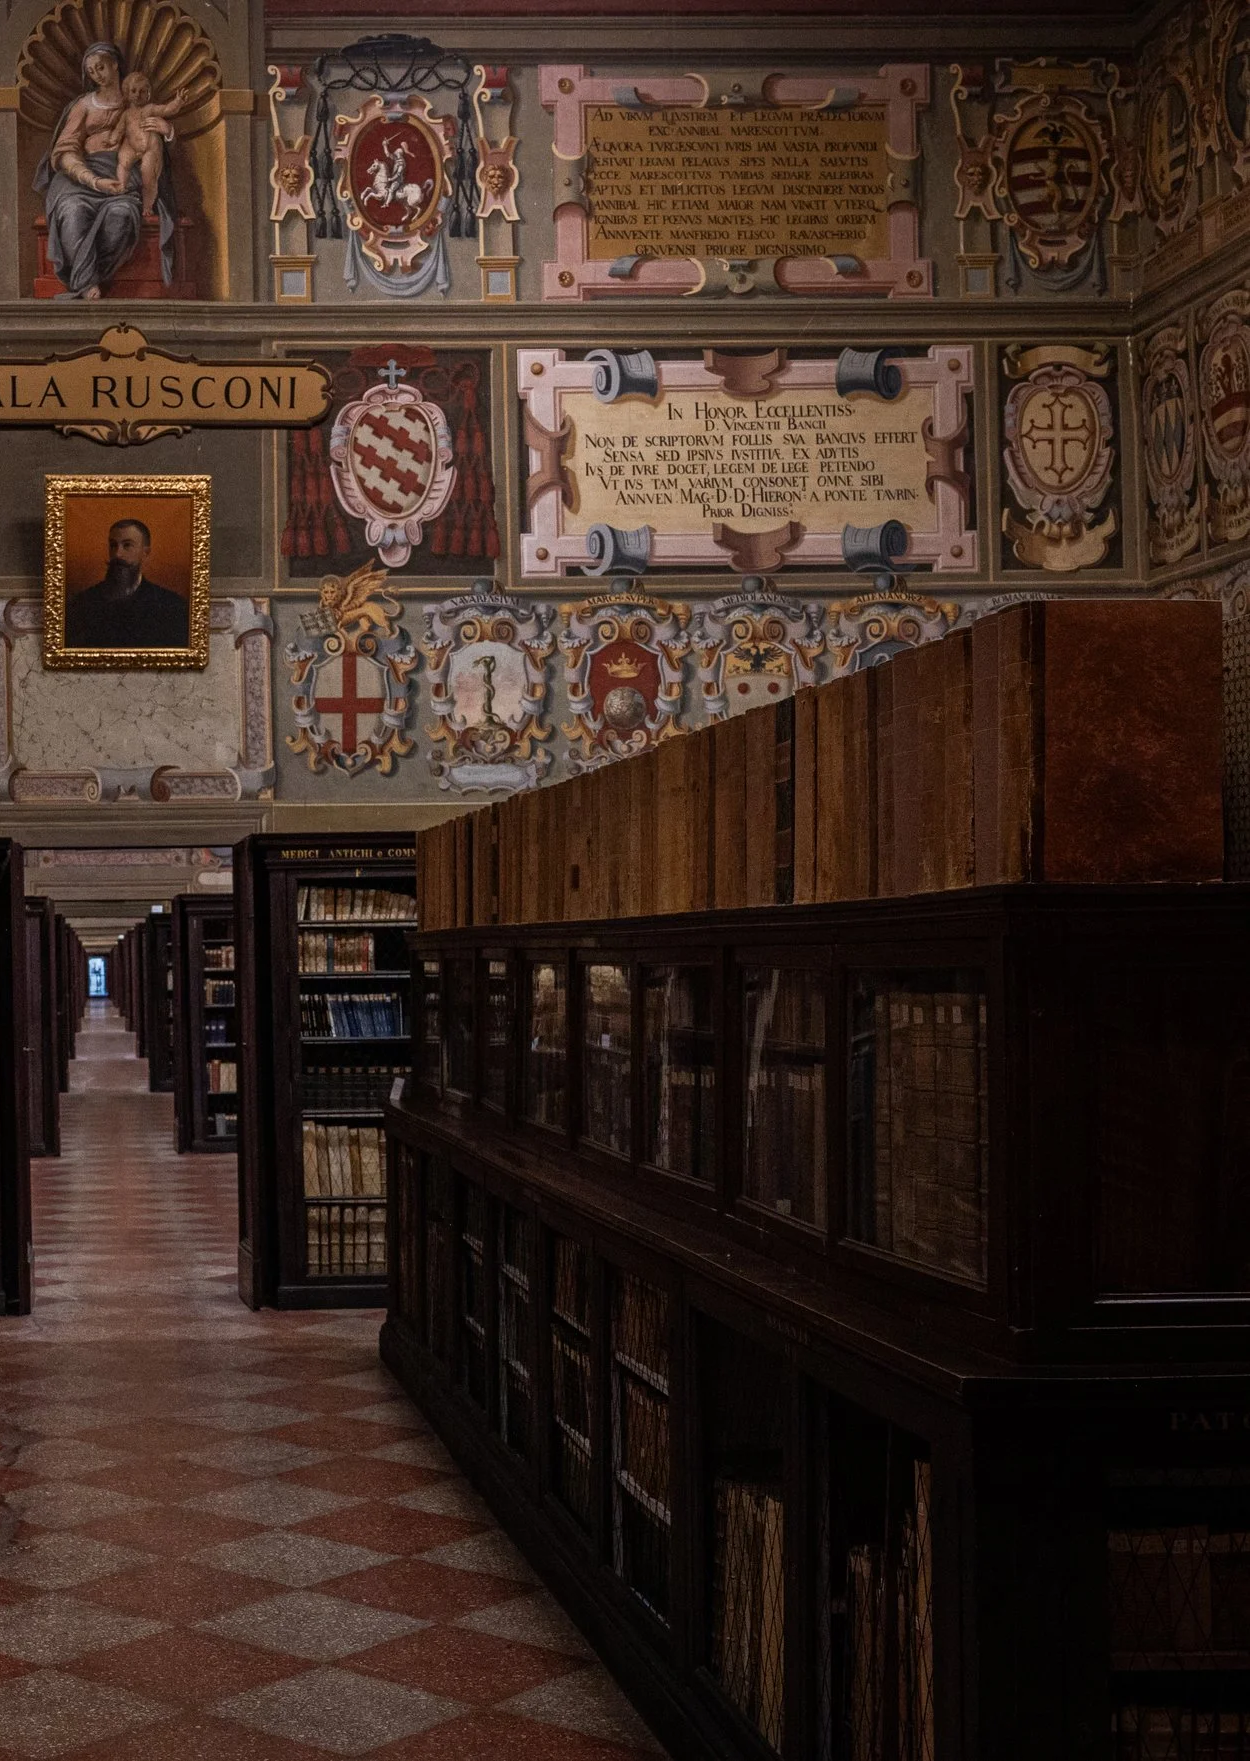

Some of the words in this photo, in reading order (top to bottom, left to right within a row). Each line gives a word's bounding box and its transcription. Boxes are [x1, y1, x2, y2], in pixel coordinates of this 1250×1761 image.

[91, 374, 296, 410] RUSCONI
[667, 403, 683, 420] IN
[695, 402, 748, 420] HONOR
[585, 434, 615, 449] NON
[622, 436, 639, 448] DE
[645, 435, 724, 447] SCRIPTORVM
[732, 434, 773, 446] FOLLIS
[783, 433, 806, 445] SVA
[603, 449, 645, 463] SENSA
[655, 450, 680, 462] SED
[687, 449, 724, 461] IPSIVS
[792, 448, 810, 460] EX
[585, 463, 603, 476] IVS
[610, 465, 625, 476] DE
[632, 464, 659, 476] IVRE
[713, 463, 755, 475] LEGEM
[762, 462, 778, 474] DE
[782, 462, 809, 473] LEGE
[820, 461, 875, 473] PETENDO
[599, 476, 620, 490] VT
[624, 479, 644, 490] IVS
[651, 478, 678, 490] TAM
[688, 477, 733, 489] VARIVM
[817, 475, 854, 487] OMNE
[861, 474, 884, 486] SIBI
[810, 490, 819, 502] A
[825, 489, 867, 501] PONTE
[702, 504, 735, 518] PRIOR
[281, 849, 319, 859] MEDICI
[330, 848, 373, 859] ANTICHI
